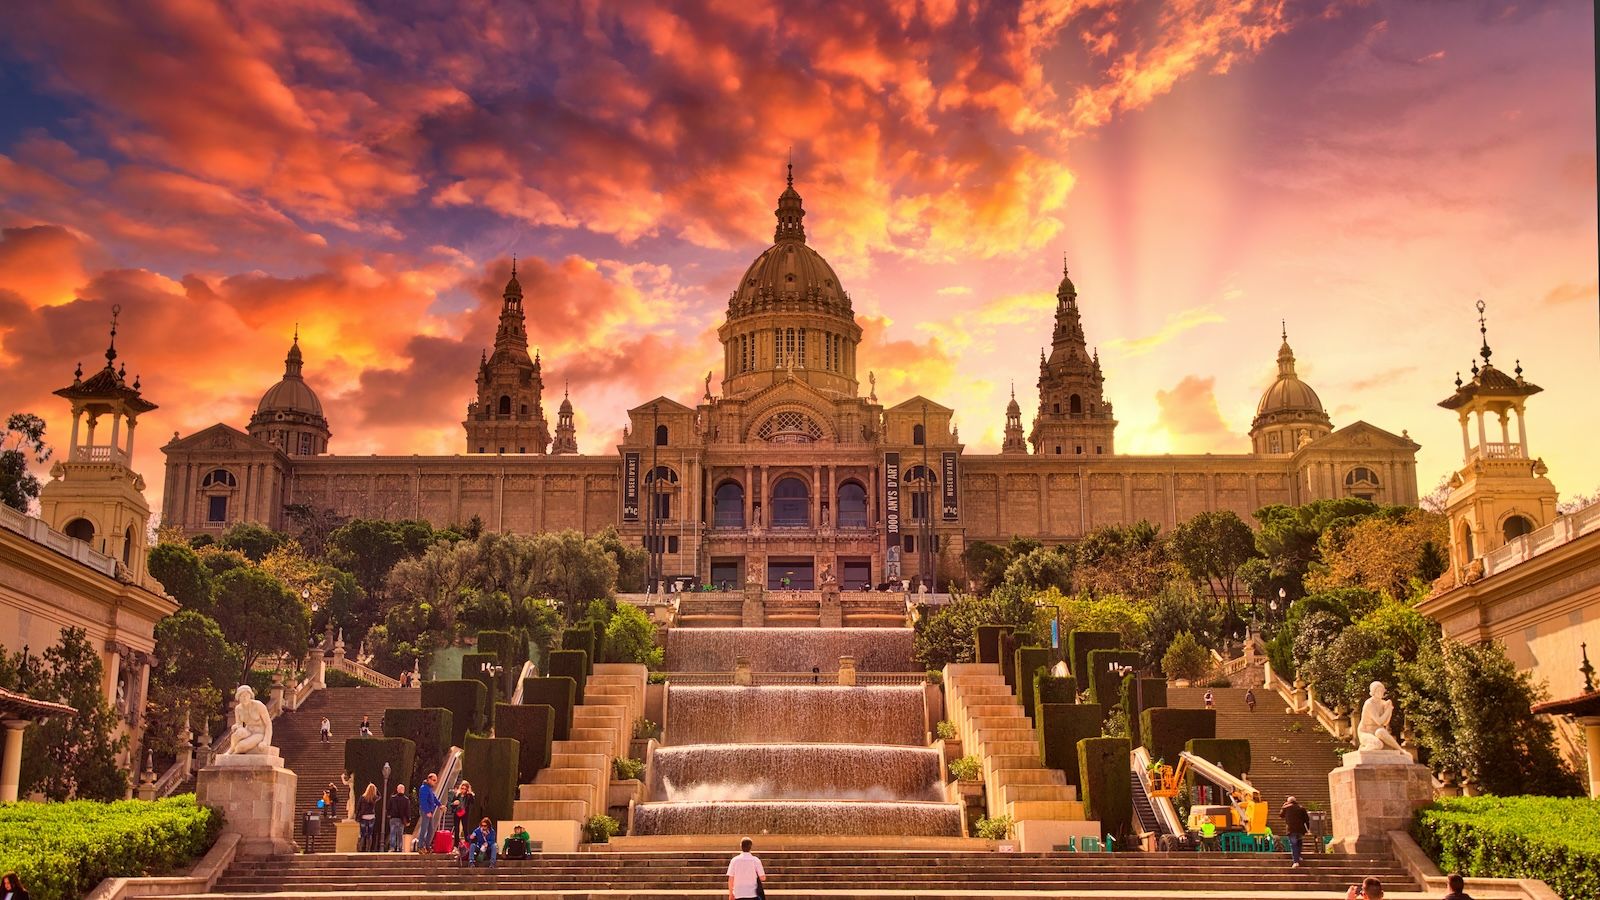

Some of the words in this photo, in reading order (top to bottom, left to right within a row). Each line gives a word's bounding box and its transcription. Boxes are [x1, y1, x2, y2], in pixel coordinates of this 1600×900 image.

[887, 464, 898, 487] D'ART
[888, 490, 898, 511] ANYS
[888, 514, 898, 534] 1000
